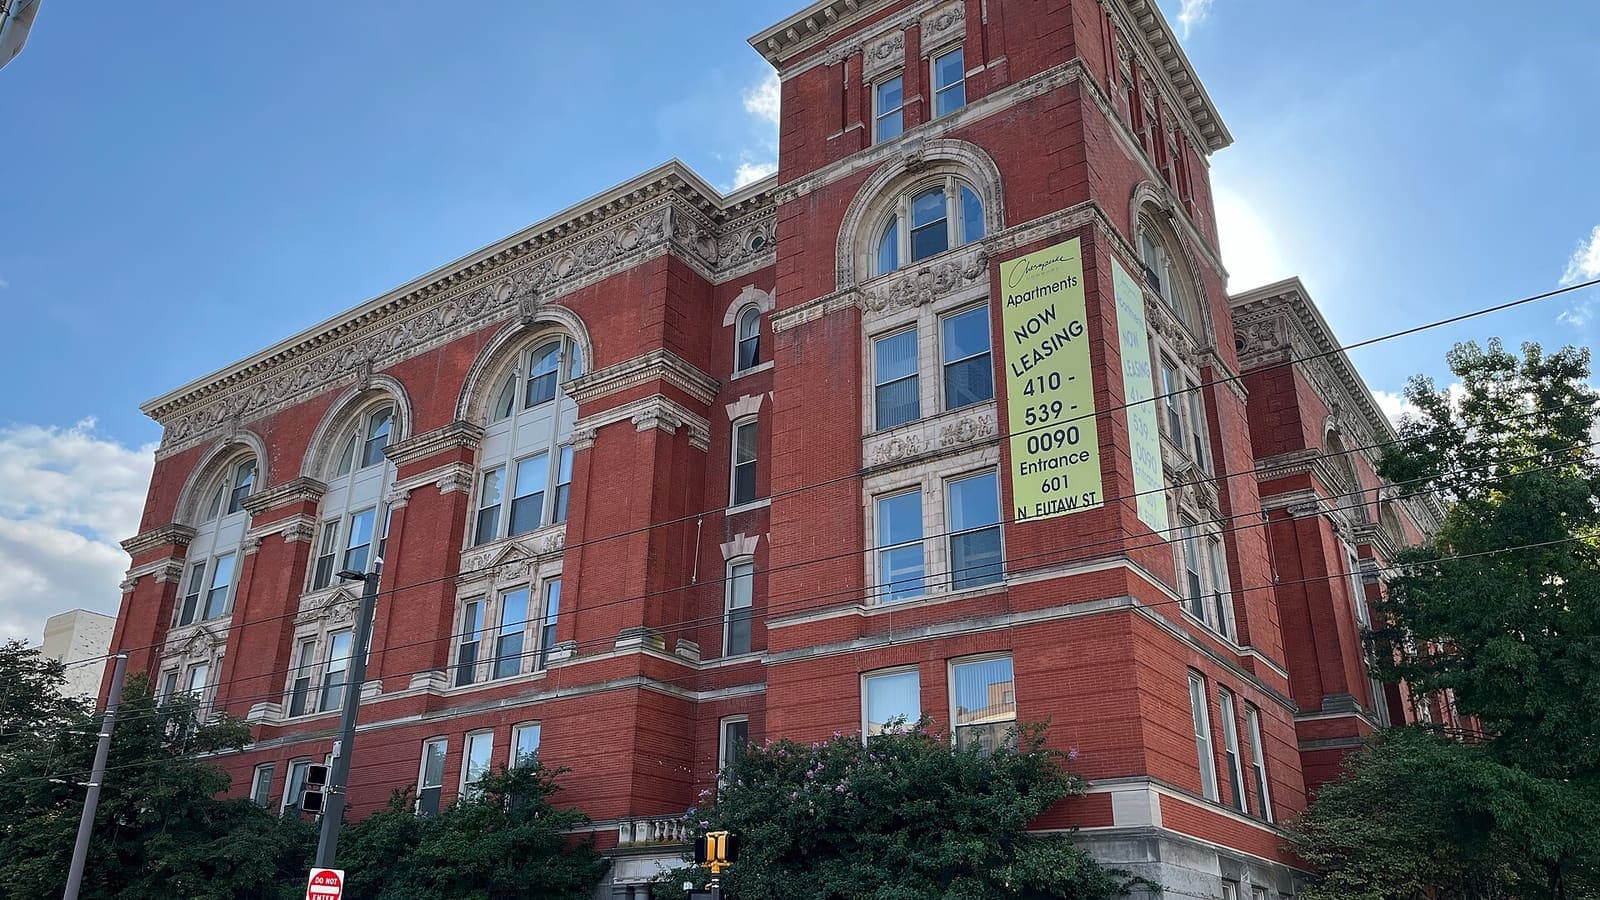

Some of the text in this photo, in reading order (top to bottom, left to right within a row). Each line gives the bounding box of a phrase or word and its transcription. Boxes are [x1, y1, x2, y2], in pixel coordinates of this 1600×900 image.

[1007, 275, 1078, 308] Apartments
[1013, 303, 1056, 344] NOW
[1011, 320, 1084, 378] LEASING
[1023, 371, 1061, 397] 410
[1025, 400, 1063, 426] 539
[1027, 425, 1080, 455] 0090
[1020, 450, 1090, 476] Entrance
[1041, 474, 1069, 493] 601
[1017, 492, 1096, 520] N EUTAW ST
[325, 877, 337, 885] NOT
